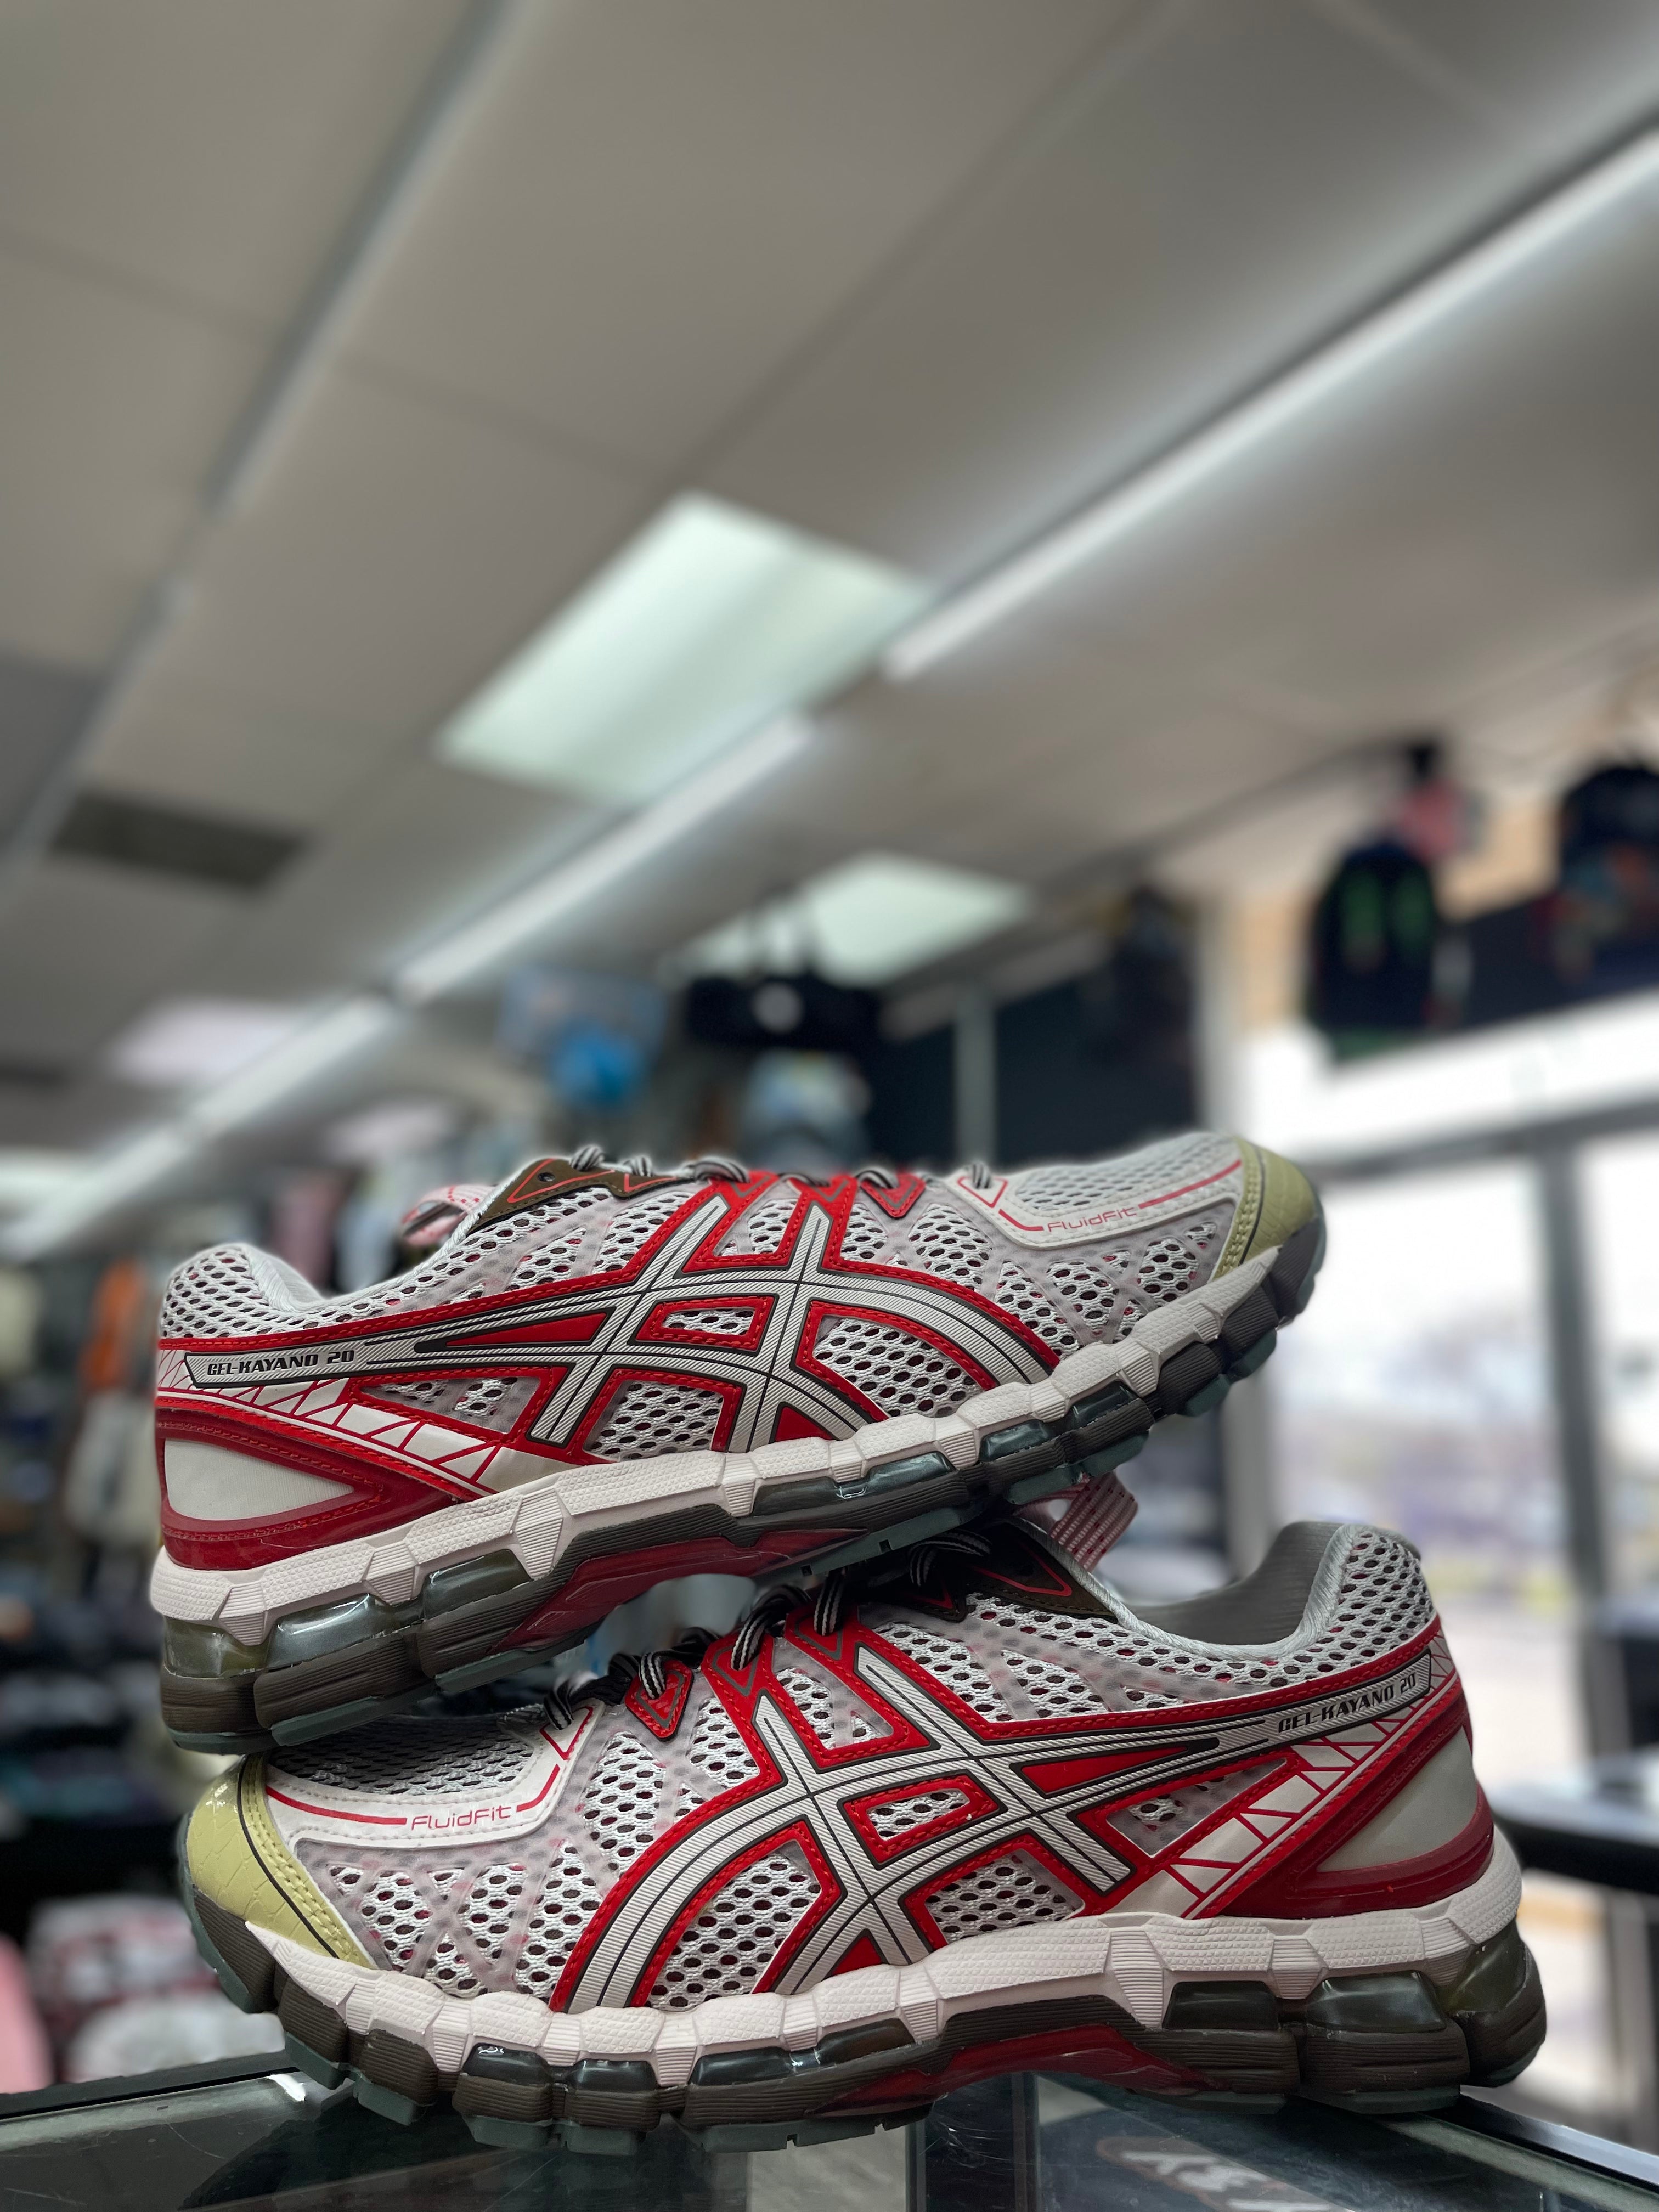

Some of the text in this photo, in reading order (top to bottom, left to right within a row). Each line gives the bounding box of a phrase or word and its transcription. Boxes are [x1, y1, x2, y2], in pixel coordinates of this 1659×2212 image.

[1047, 1207, 1137, 1232] FluidFit
[207, 1350, 355, 1376] GEL-KAYANO 20
[1278, 1673, 1417, 1733] GEL-KAYANO 20
[411, 1805, 512, 1831] FluidFit
